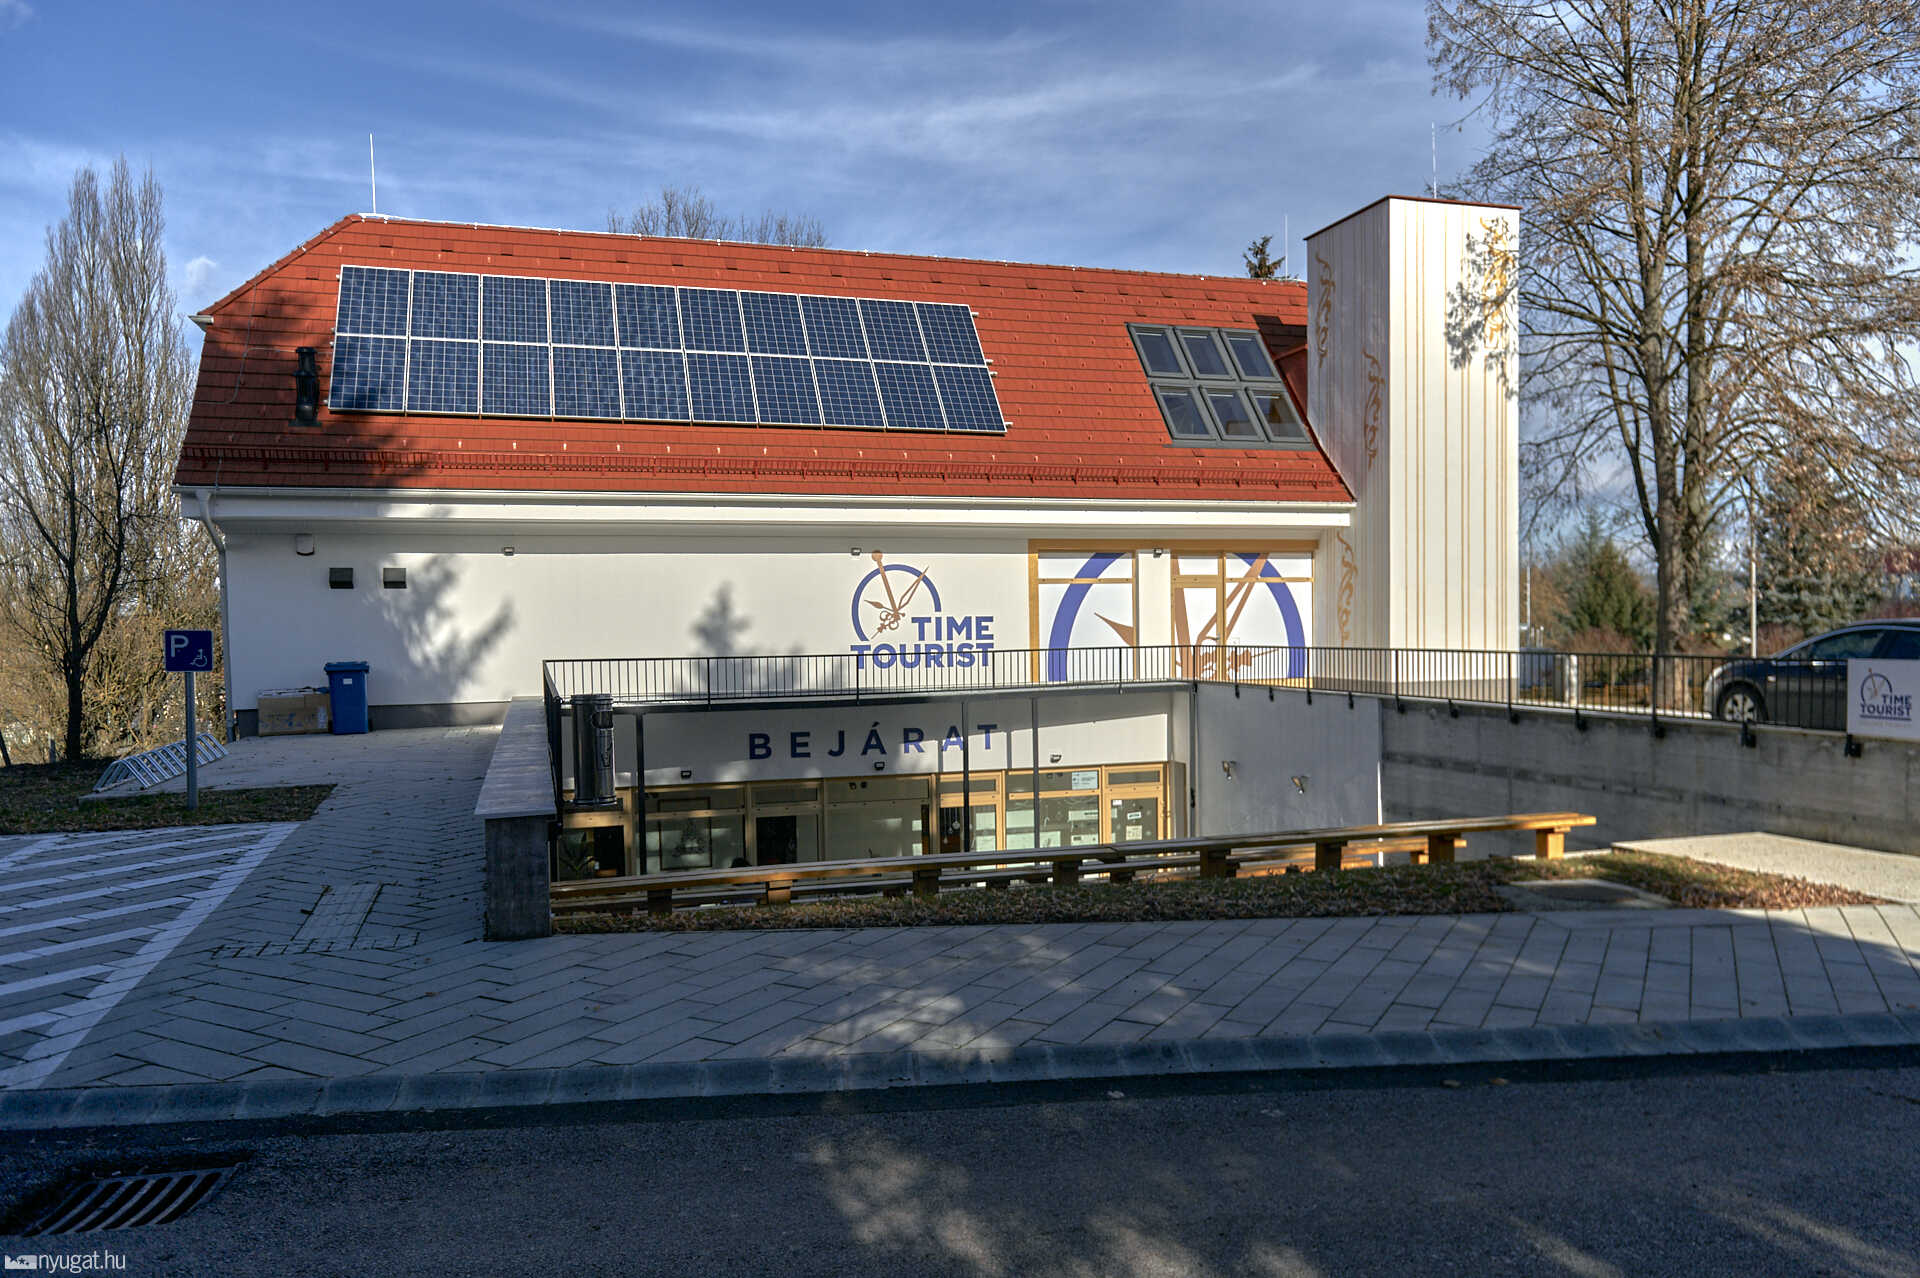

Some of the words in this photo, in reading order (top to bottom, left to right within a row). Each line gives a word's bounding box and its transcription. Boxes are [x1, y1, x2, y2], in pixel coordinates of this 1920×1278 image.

[911, 616, 994, 641] TIME
[171, 635, 189, 657] P
[850, 642, 994, 669] TOURIST
[1860, 703, 1912, 717] TOURIST
[1881, 694, 1912, 705] TIME
[749, 721, 997, 760] BEJÁRAT
